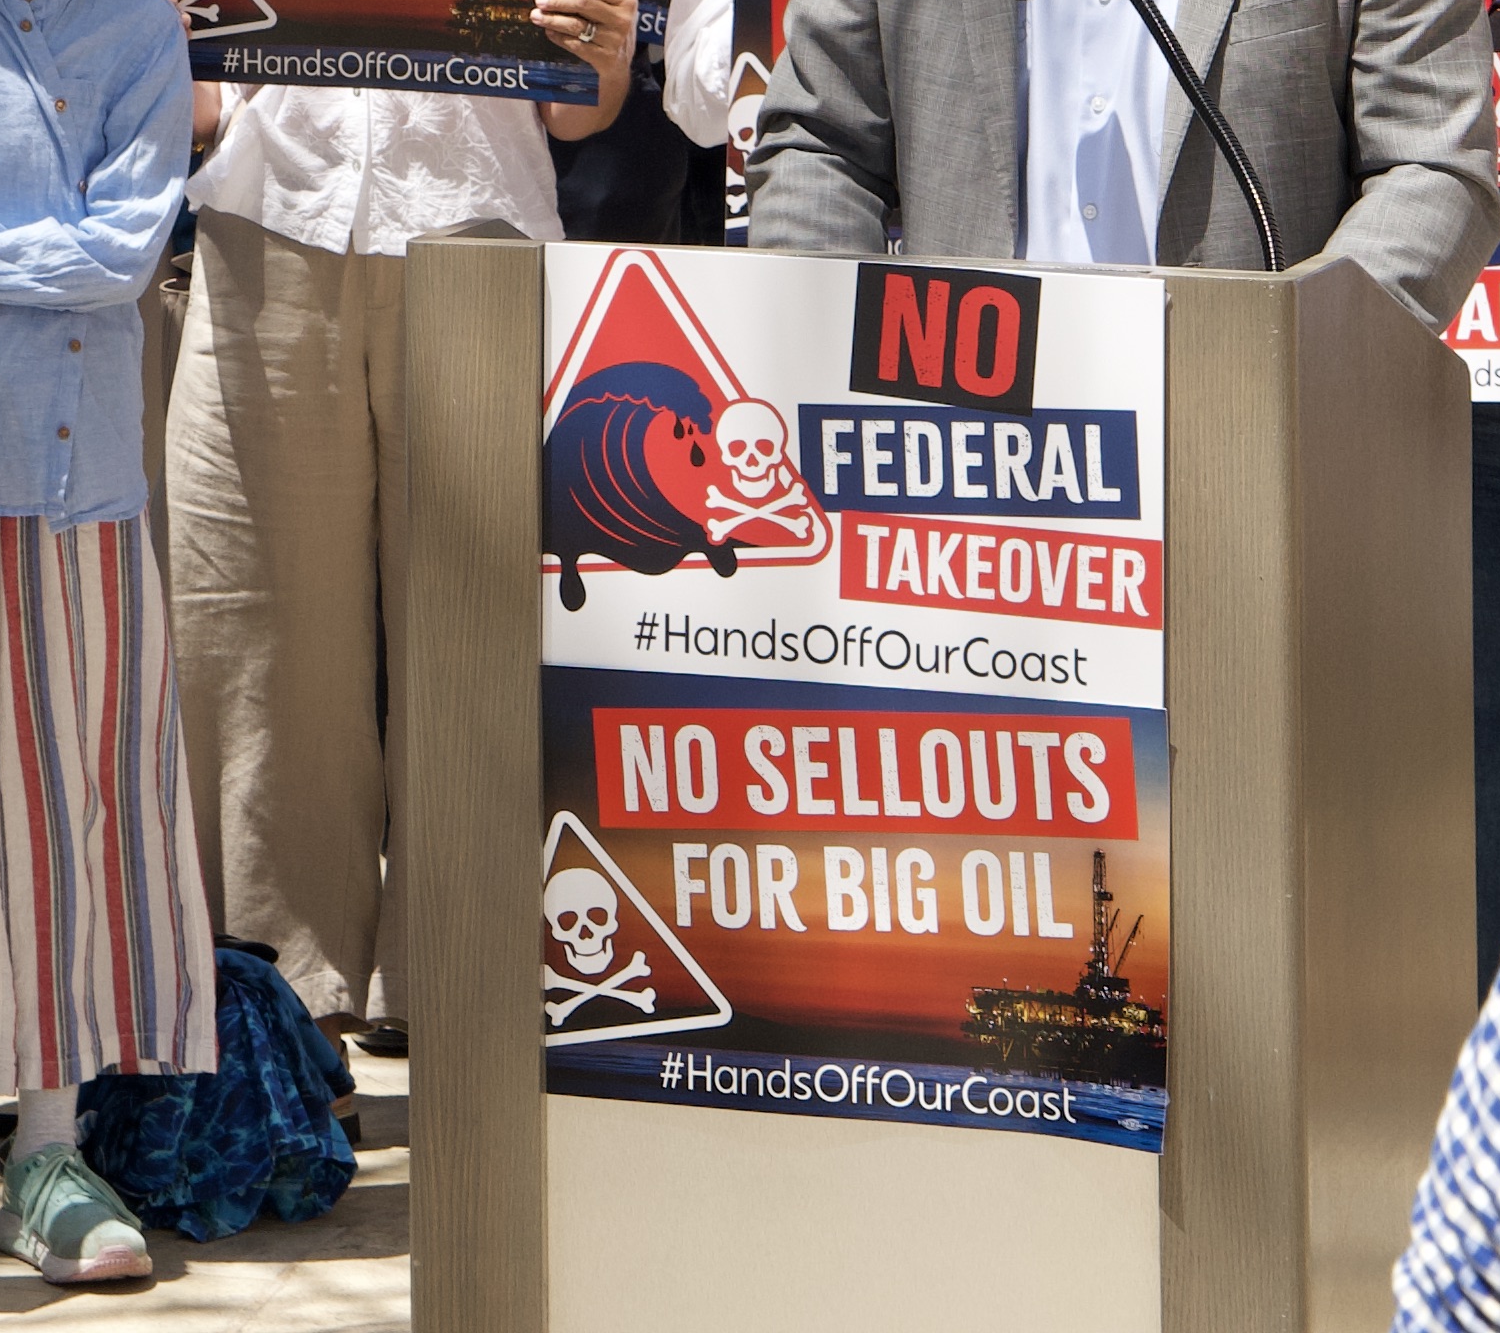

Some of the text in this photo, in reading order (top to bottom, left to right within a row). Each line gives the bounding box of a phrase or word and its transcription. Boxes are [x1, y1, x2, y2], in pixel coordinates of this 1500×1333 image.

[222, 47, 529, 91] #HandsOffOurCoast
[877, 275, 1021, 395] NO
[822, 419, 1121, 505] FEDERAL
[858, 525, 1150, 614] TAKEOVER
[633, 612, 1089, 687] #HandsOffOurCoast
[620, 724, 1111, 824] NO SELLOUTS
[675, 843, 1074, 940] FOR BIG OIL
[661, 1052, 1077, 1124] #HandsOffOurCoast
